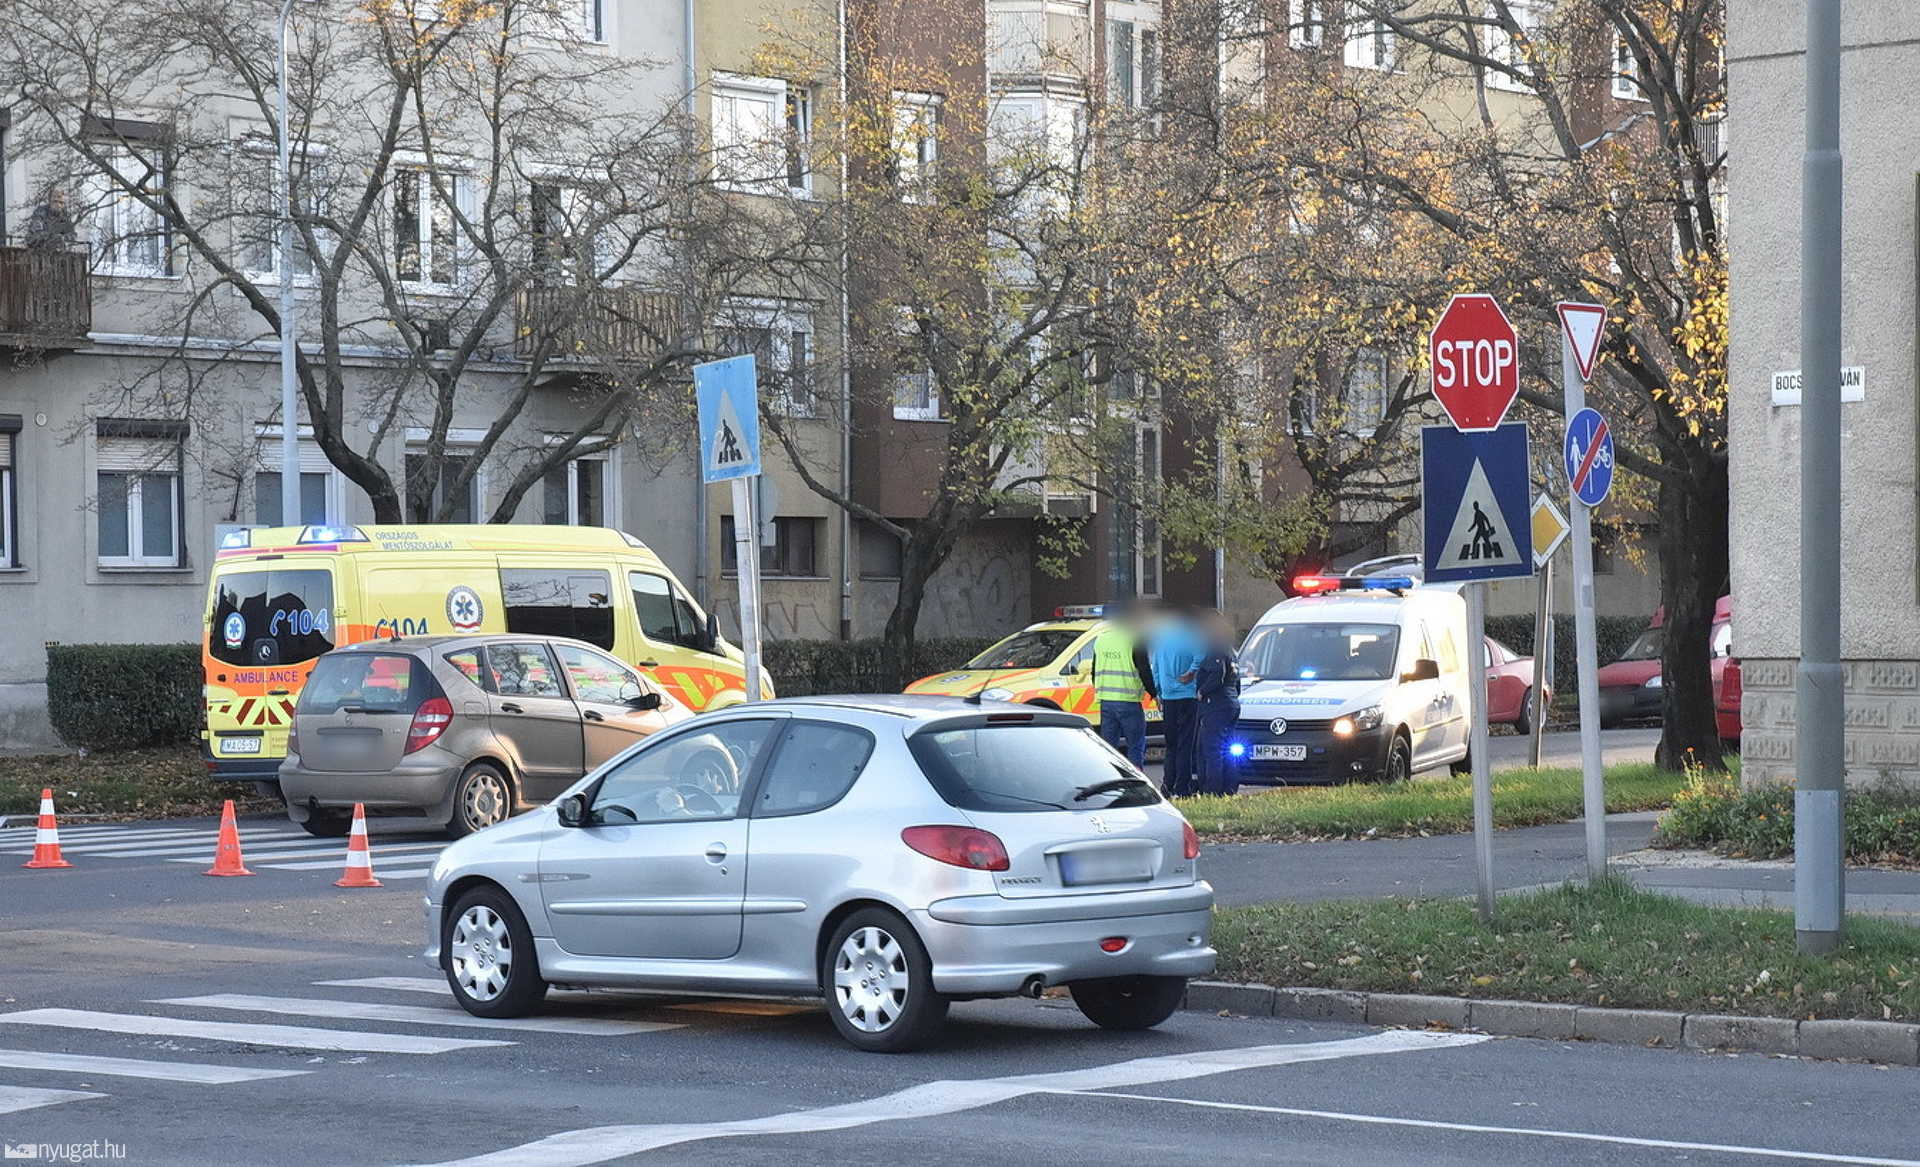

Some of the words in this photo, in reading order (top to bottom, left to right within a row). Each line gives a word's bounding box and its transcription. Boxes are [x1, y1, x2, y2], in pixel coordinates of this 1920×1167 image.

[1437, 338, 1513, 387] STOP
[1775, 375, 1802, 390] BOCS
[1840, 367, 1861, 386] VÁN
[287, 608, 329, 636] 104
[234, 671, 299, 684] AMBULANCE
[1255, 745, 1304, 758] MPW-357
